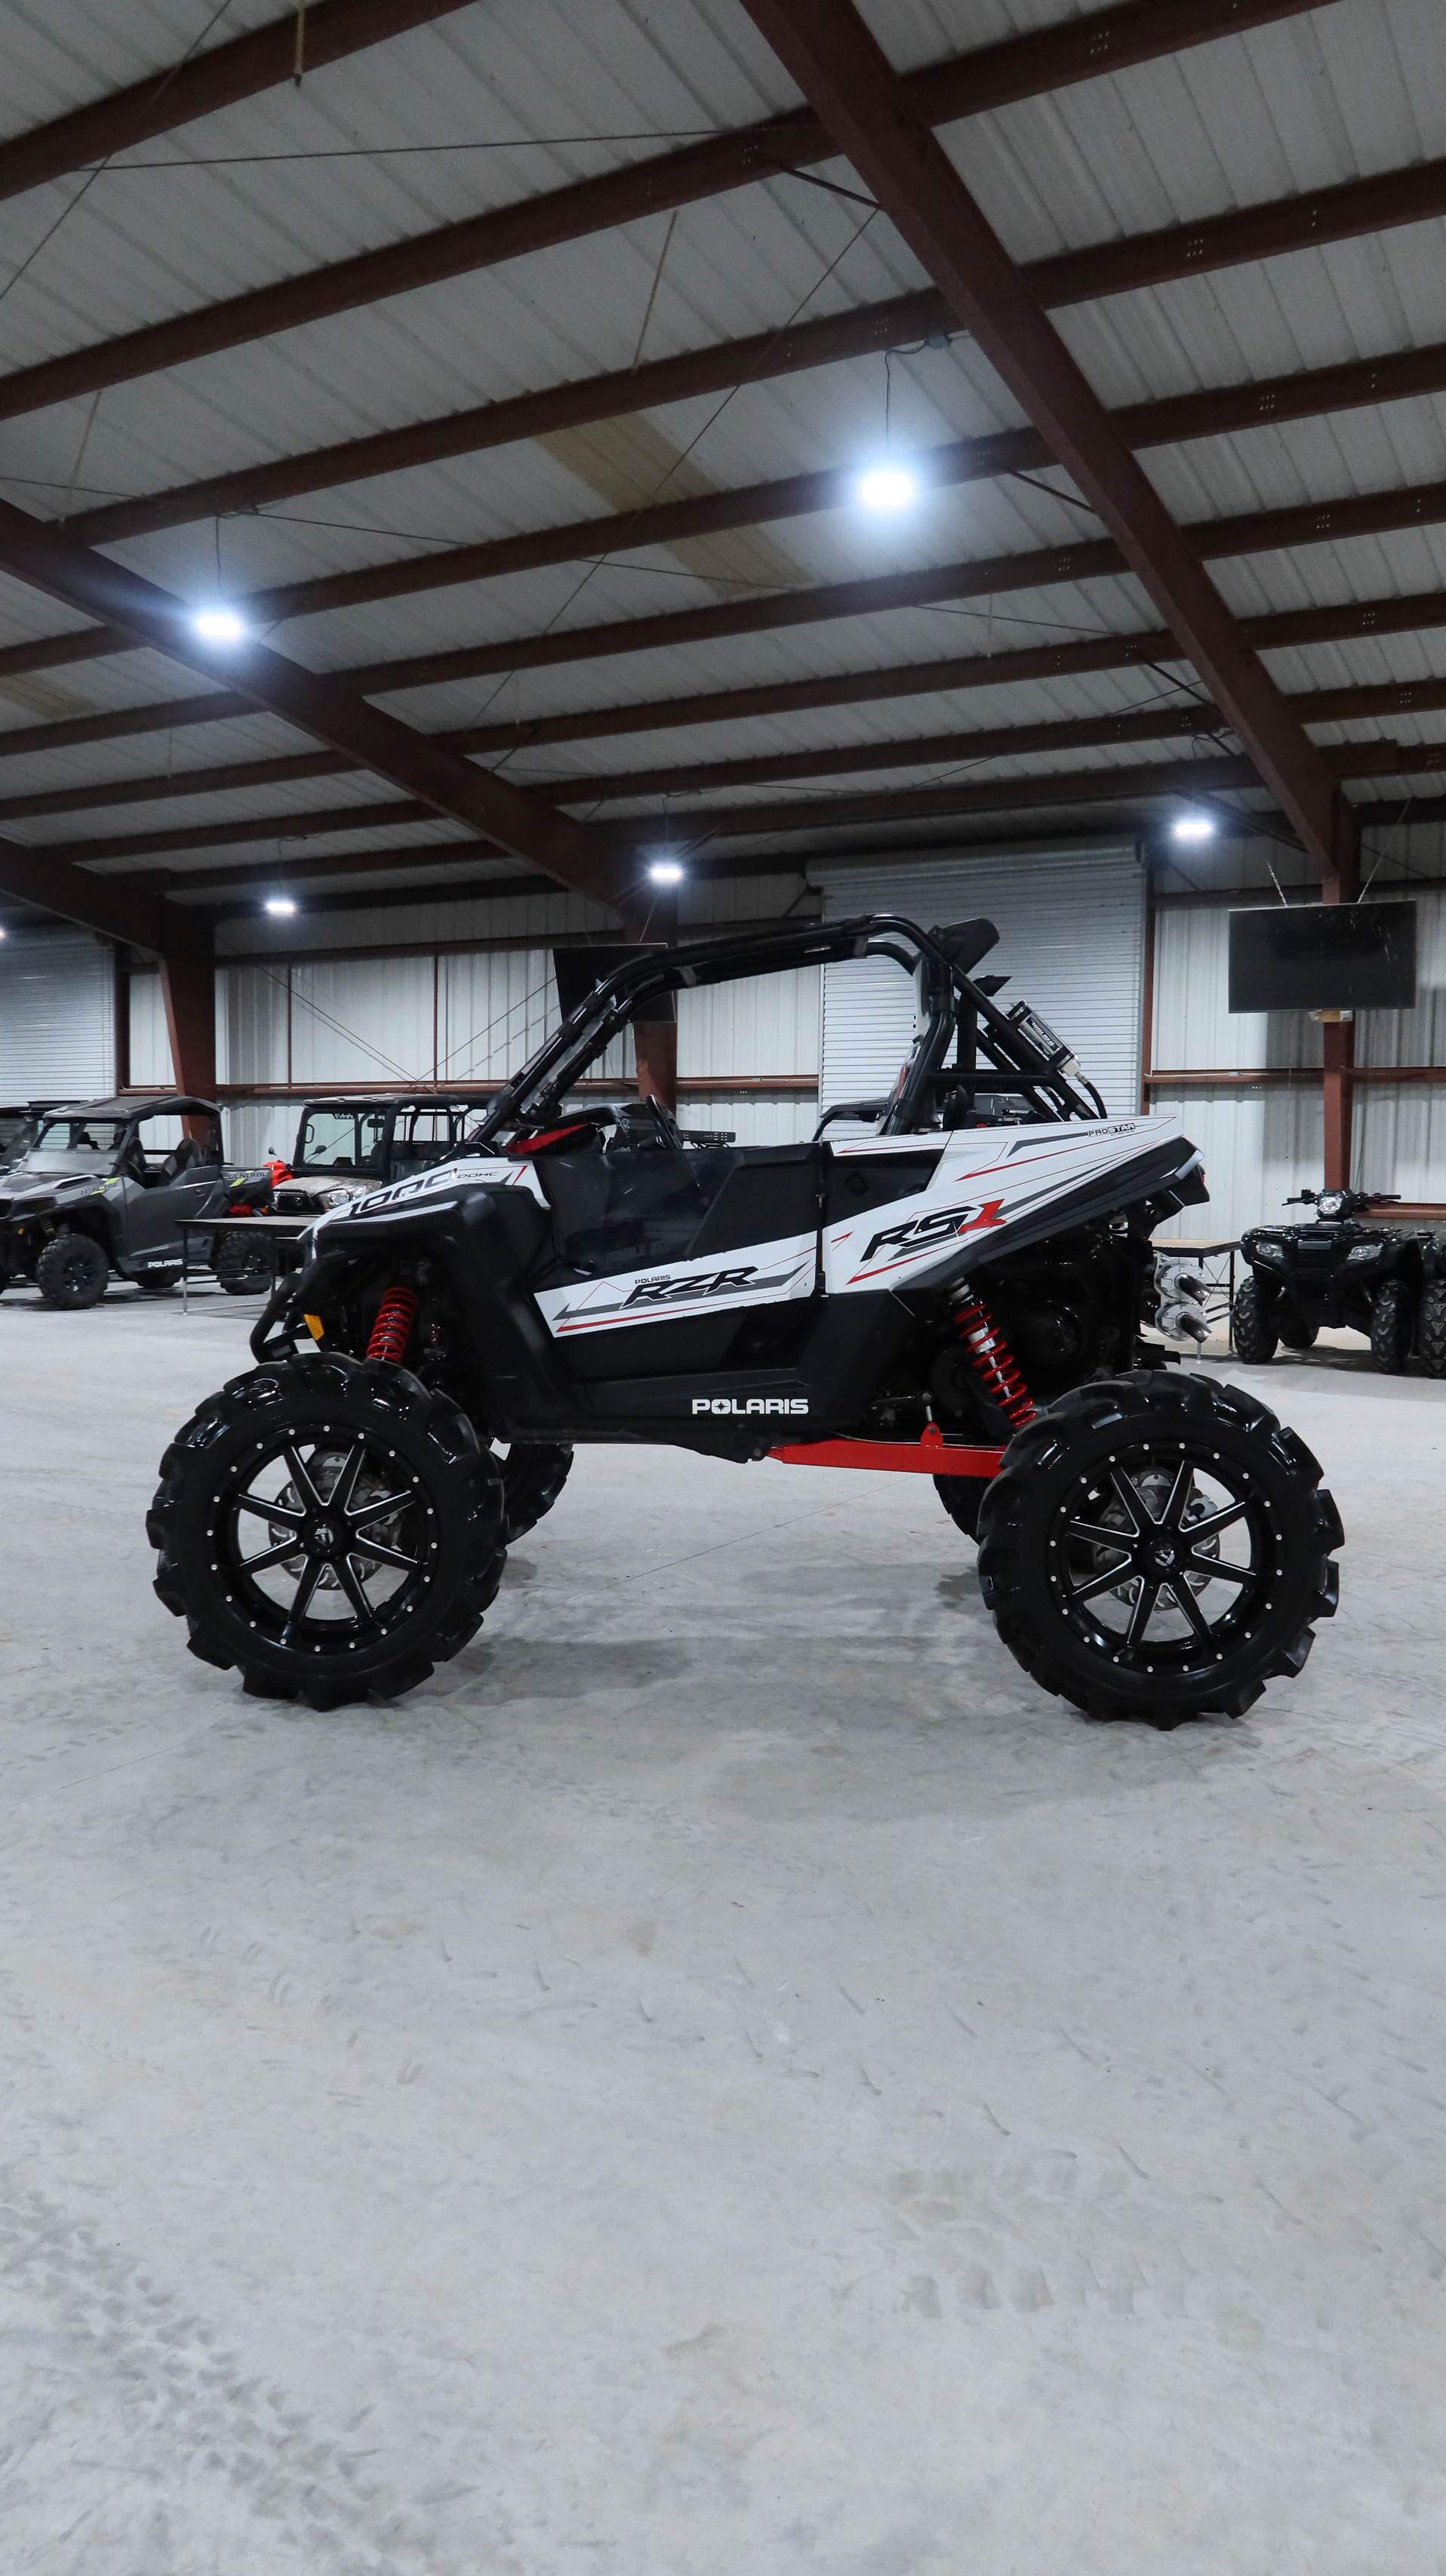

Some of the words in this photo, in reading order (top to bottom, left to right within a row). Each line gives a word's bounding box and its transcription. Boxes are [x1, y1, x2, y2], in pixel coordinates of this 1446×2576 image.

[1088, 1123, 1136, 1137] PROSTAR
[228, 1172, 267, 1180] GENERAL
[859, 1198, 1008, 1262] RS1
[148, 1259, 183, 1268] POLARIS
[635, 1274, 671, 1284] POLARIS
[619, 1266, 759, 1309] RZR
[692, 1399, 809, 1415] POLARIS
